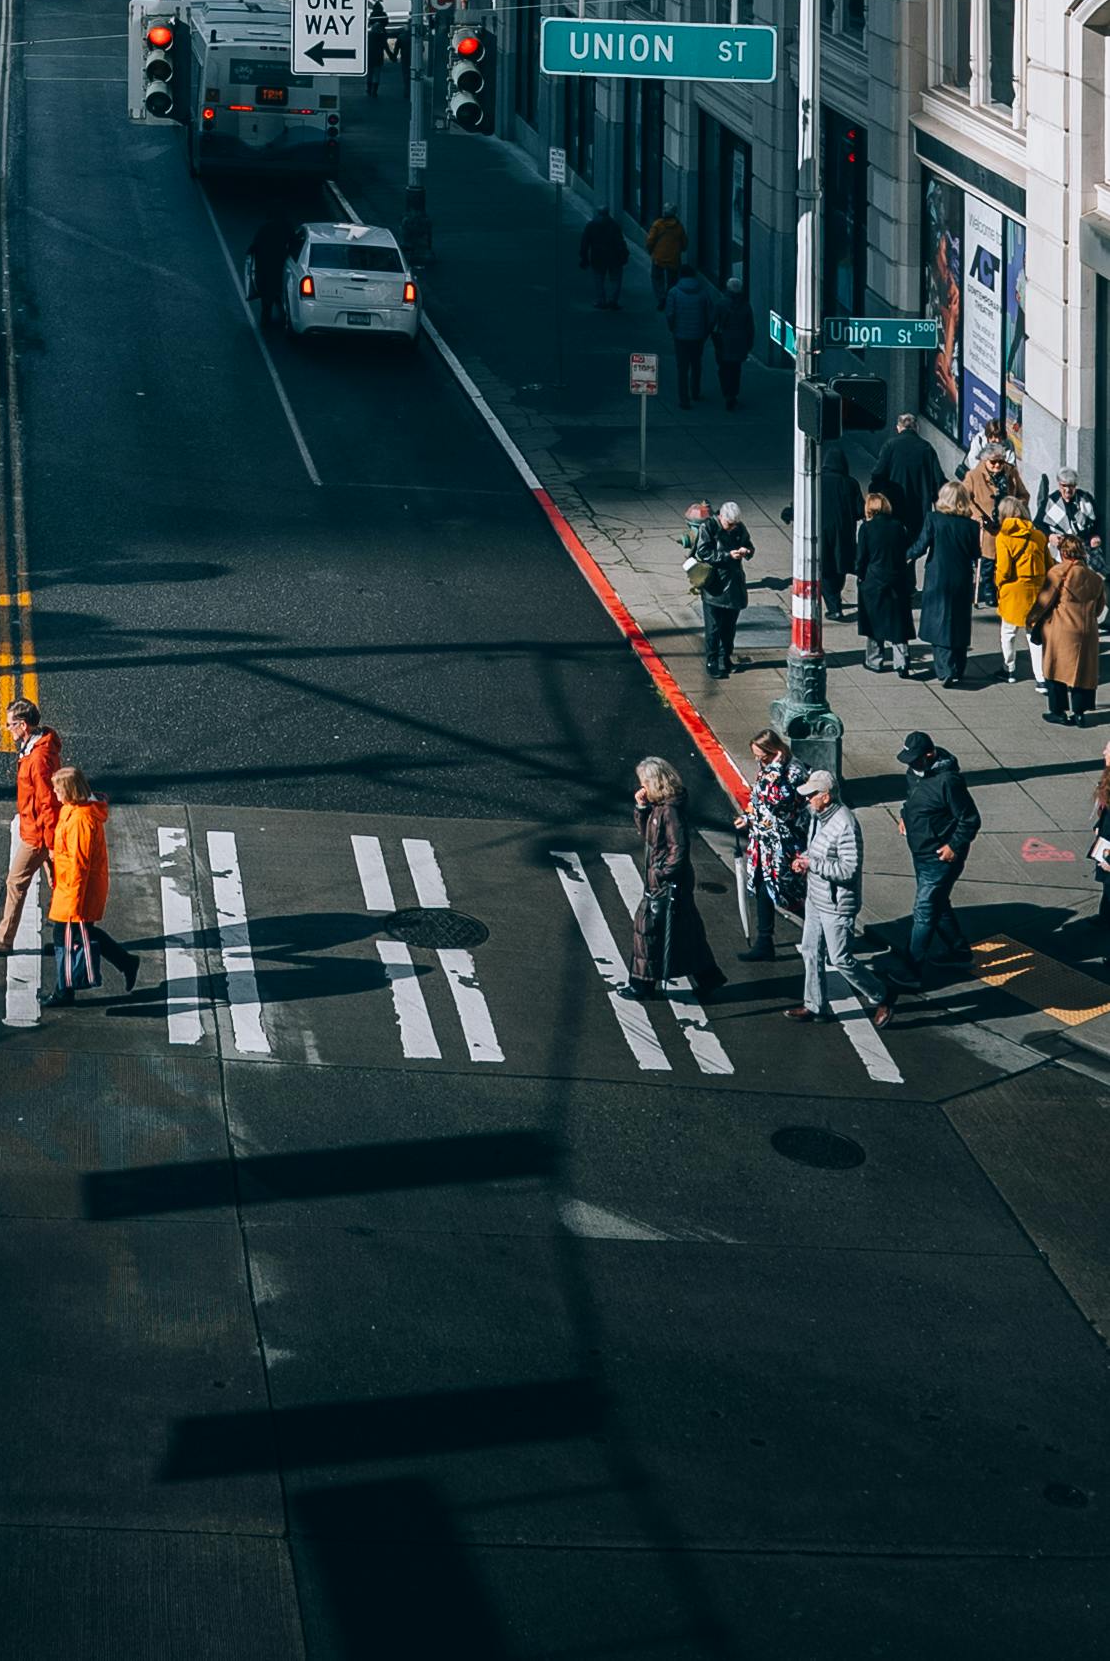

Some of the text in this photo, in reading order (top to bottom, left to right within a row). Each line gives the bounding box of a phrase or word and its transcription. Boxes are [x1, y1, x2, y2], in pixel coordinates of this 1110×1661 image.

[305, 14, 355, 35] WAY
[569, 31, 748, 63] UNION ST
[969, 244, 1000, 293] ACT
[830, 321, 936, 345] Union St 1500
